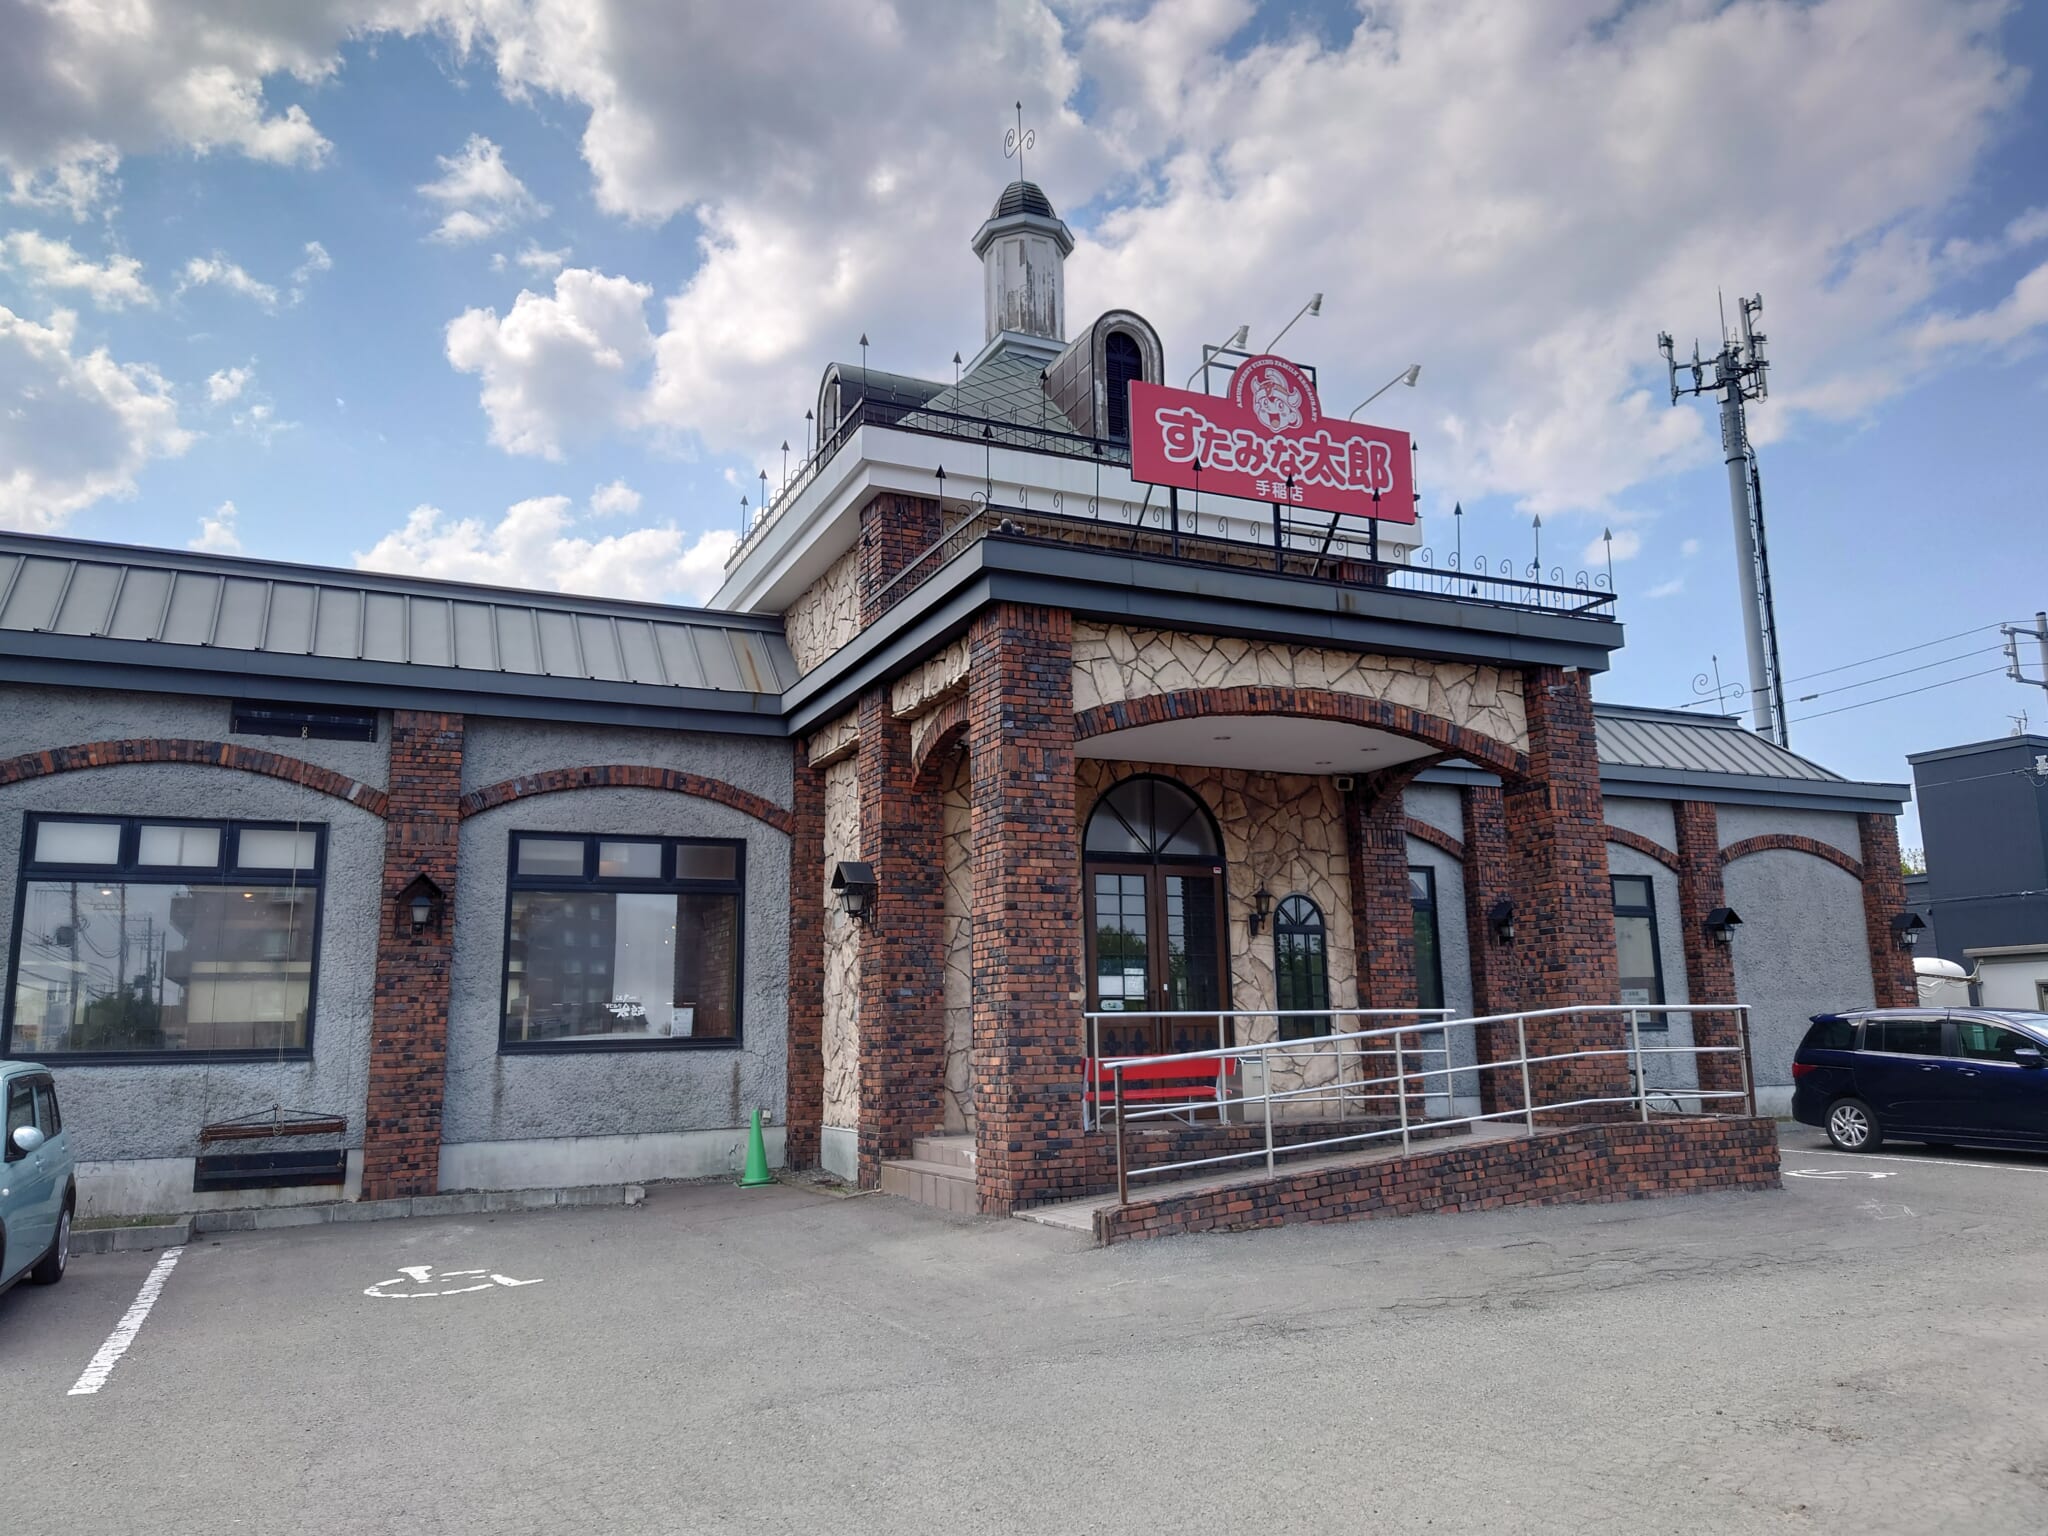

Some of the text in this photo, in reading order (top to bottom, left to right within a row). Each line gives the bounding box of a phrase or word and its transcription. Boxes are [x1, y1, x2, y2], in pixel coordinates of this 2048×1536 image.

[1274, 360, 1299, 377] FAMILY
[1297, 374, 1317, 422] RESTAURANT
[1155, 407, 1393, 494] すたみな太郎
[1255, 479, 1304, 502] 手稲店
